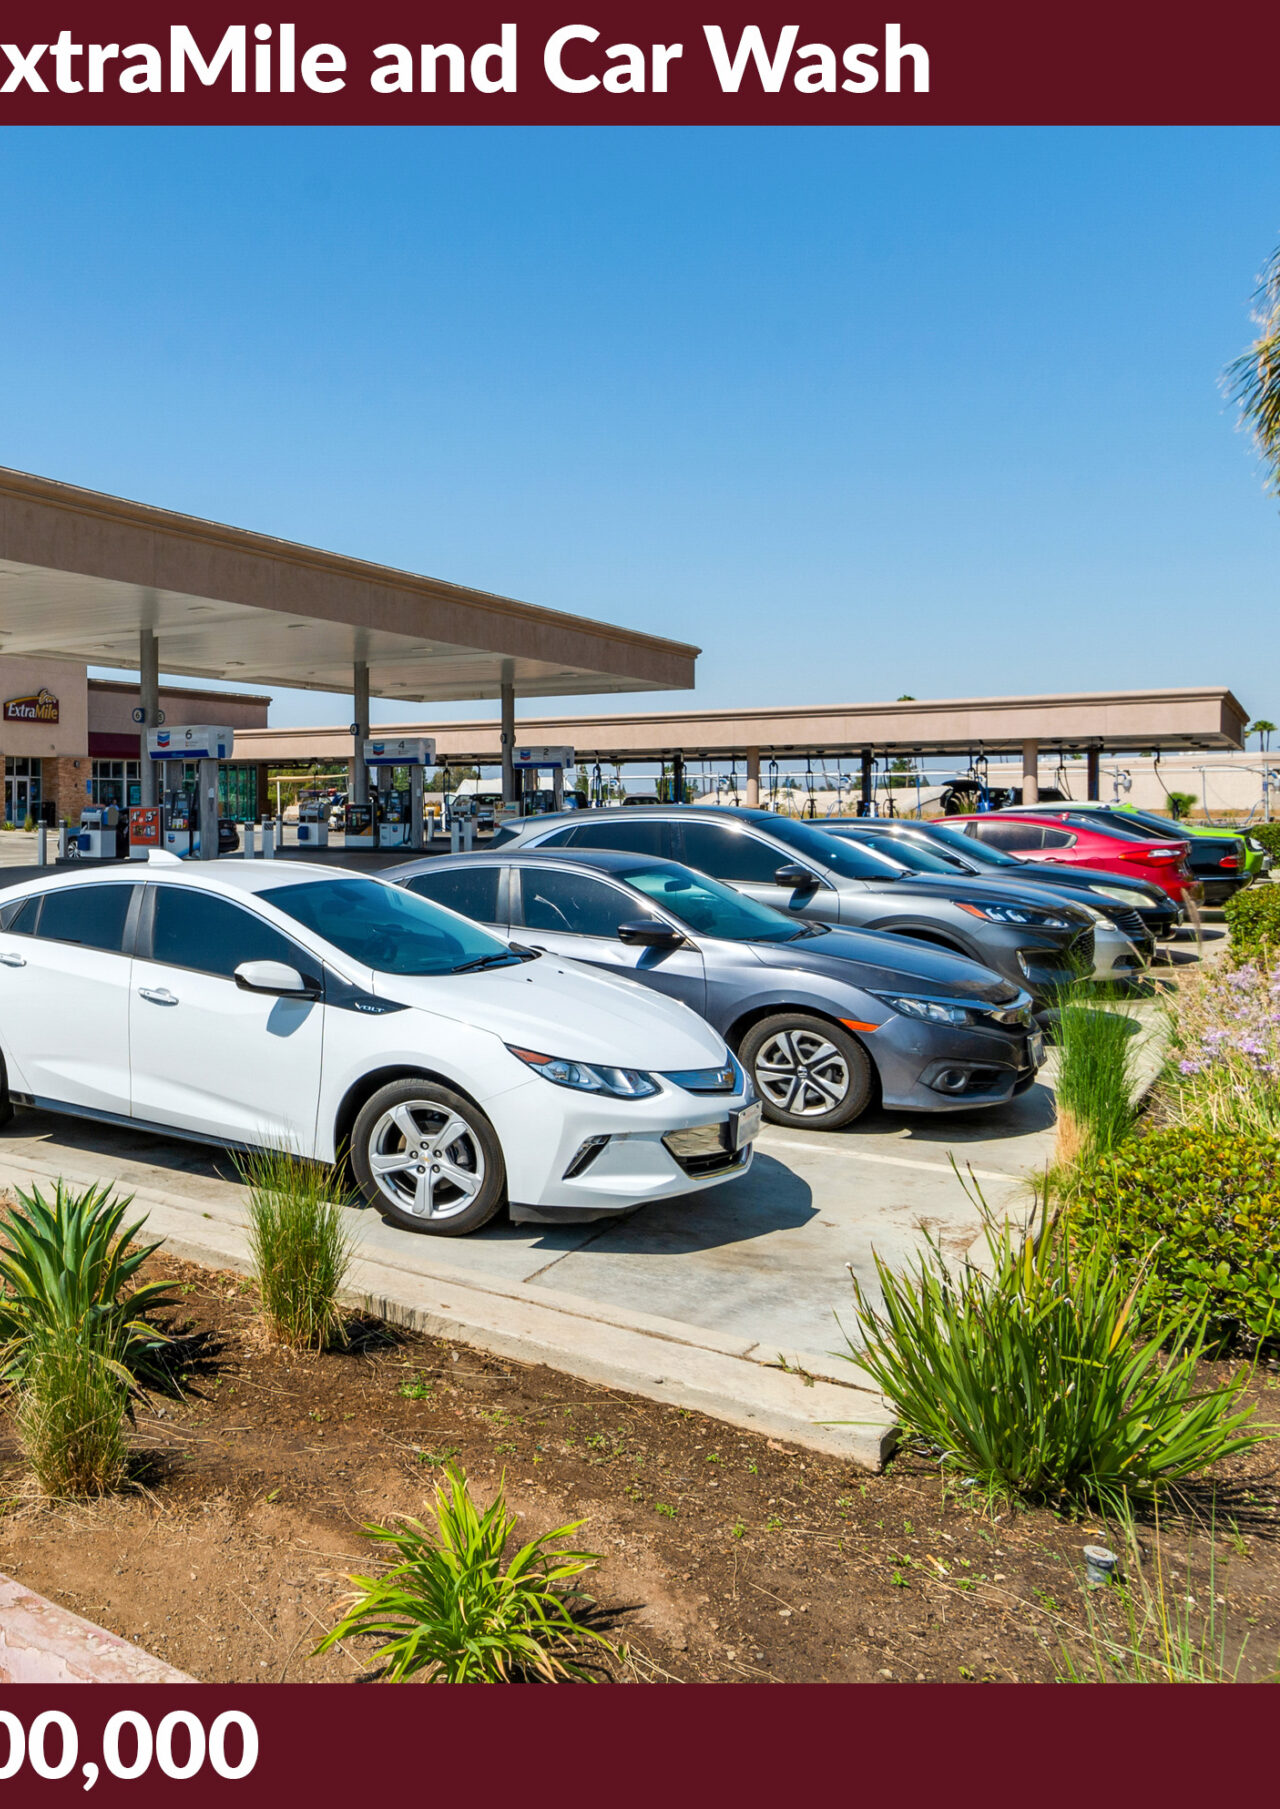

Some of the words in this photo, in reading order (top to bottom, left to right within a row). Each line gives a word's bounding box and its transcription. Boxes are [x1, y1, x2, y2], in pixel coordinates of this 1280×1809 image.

[8, 702, 58, 720] ExtraMile
[185, 729, 192, 740] 6
[398, 740, 405, 749] 4
[543, 748, 549, 756] 2
[354, 1002, 385, 1013] VOLT
